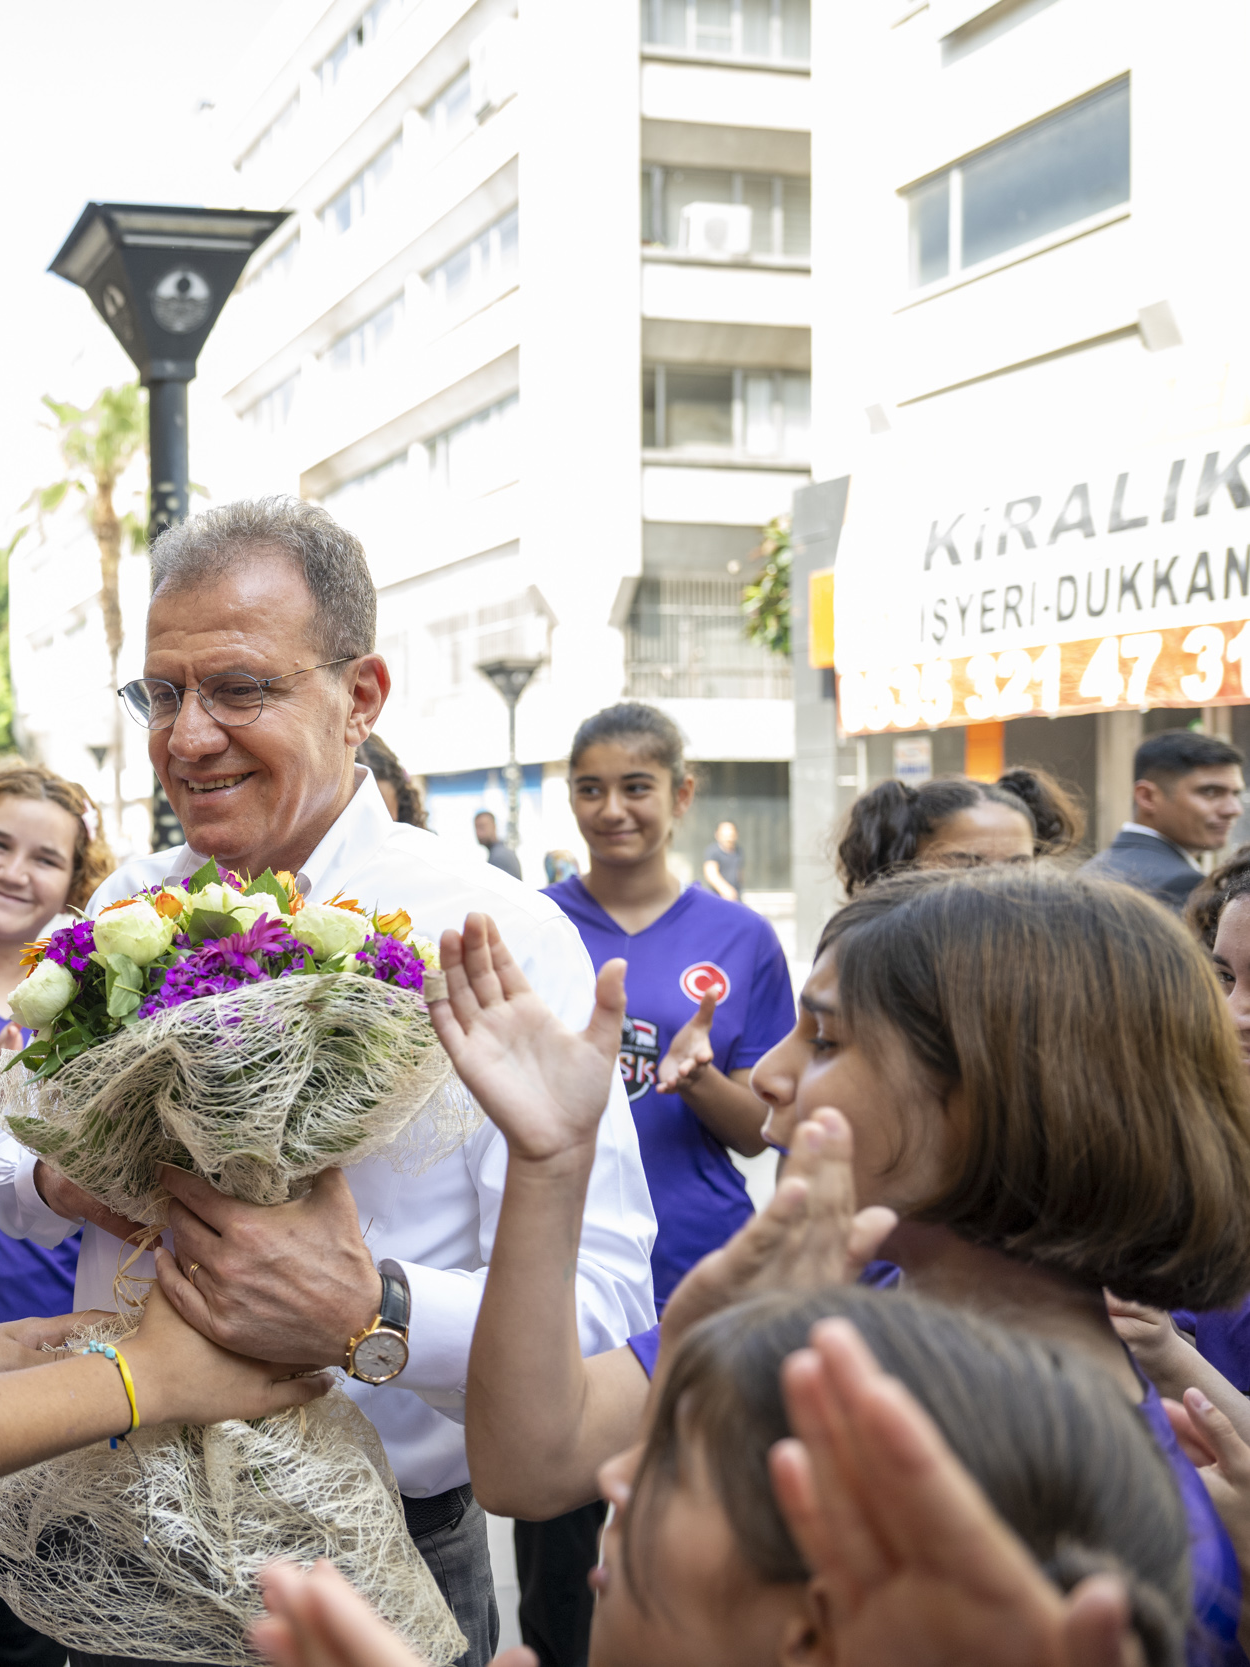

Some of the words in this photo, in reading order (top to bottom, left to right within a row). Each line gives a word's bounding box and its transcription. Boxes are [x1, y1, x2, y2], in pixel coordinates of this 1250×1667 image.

[964, 643, 1061, 720] 321
[1079, 632, 1163, 707] 47
[619, 1051, 657, 1084] SK
